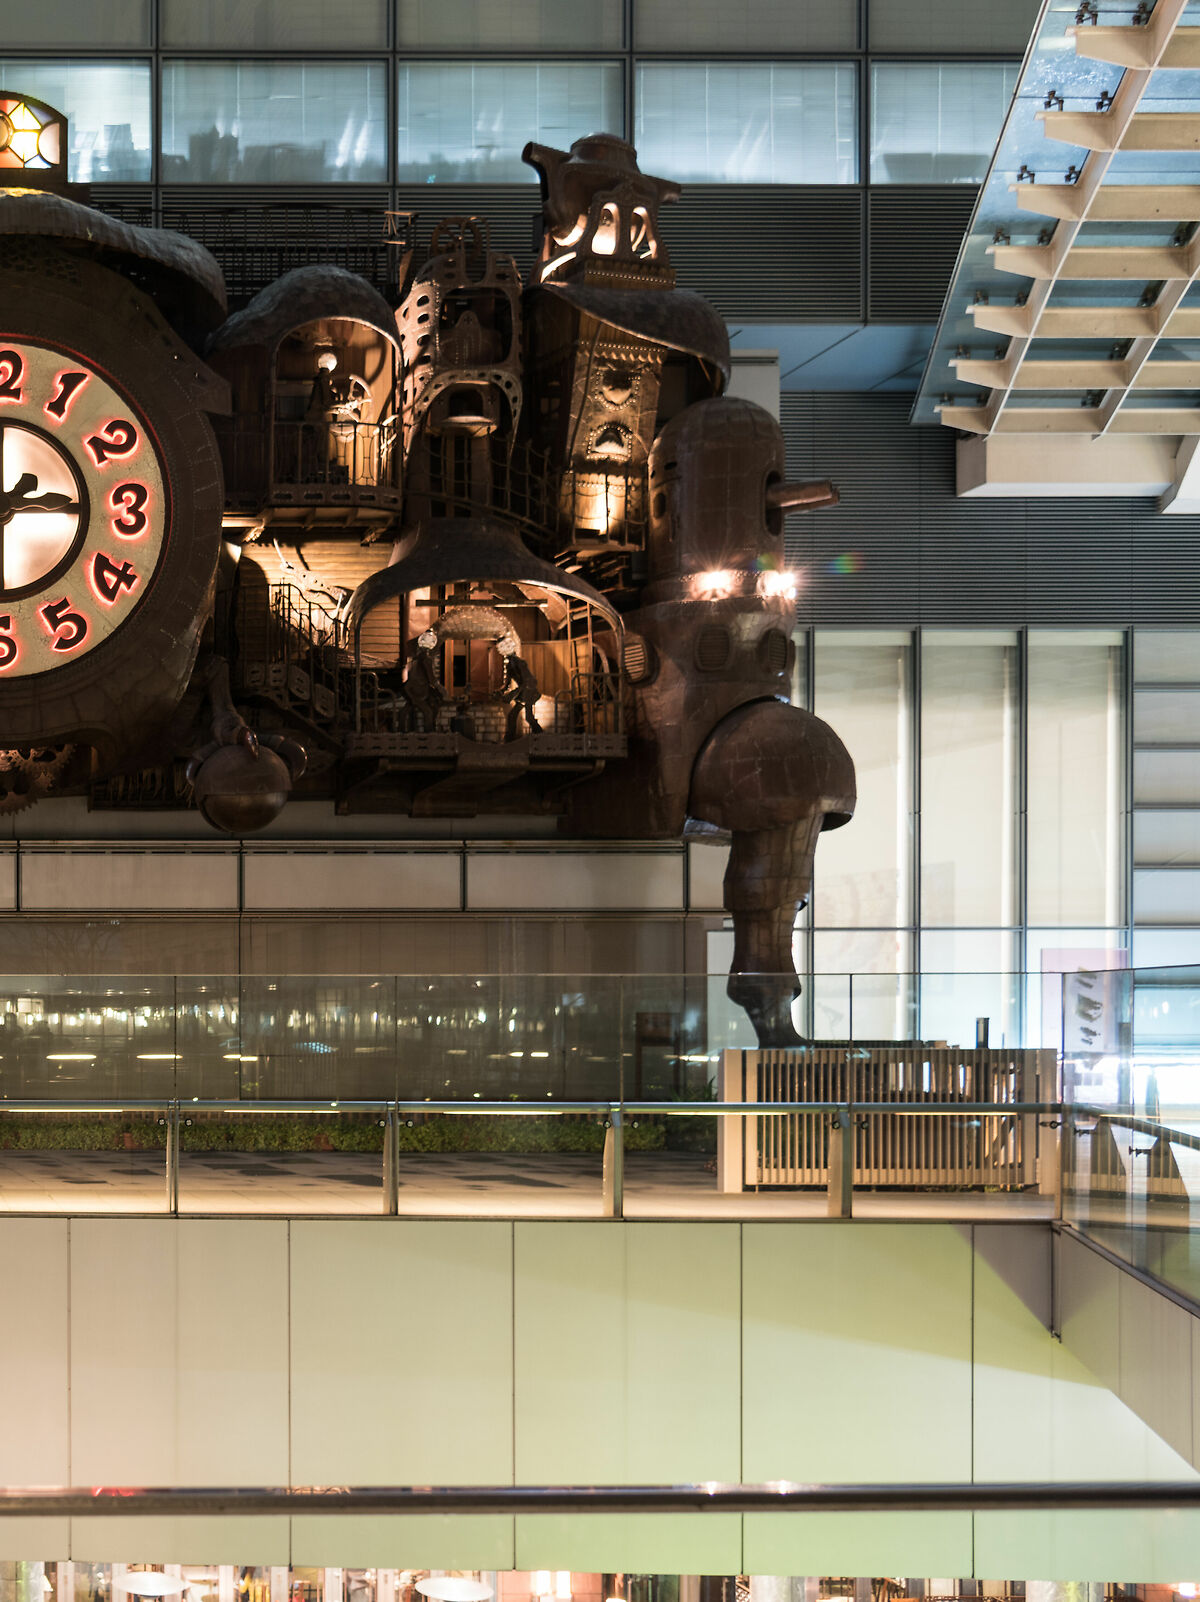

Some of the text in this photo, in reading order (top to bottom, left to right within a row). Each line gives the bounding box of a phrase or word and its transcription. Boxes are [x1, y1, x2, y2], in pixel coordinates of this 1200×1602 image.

[46, 372, 88, 418] 1
[87, 419, 138, 464] 2
[112, 483, 148, 535] 3
[93, 552, 138, 602] 4
[41, 597, 88, 650] 5
